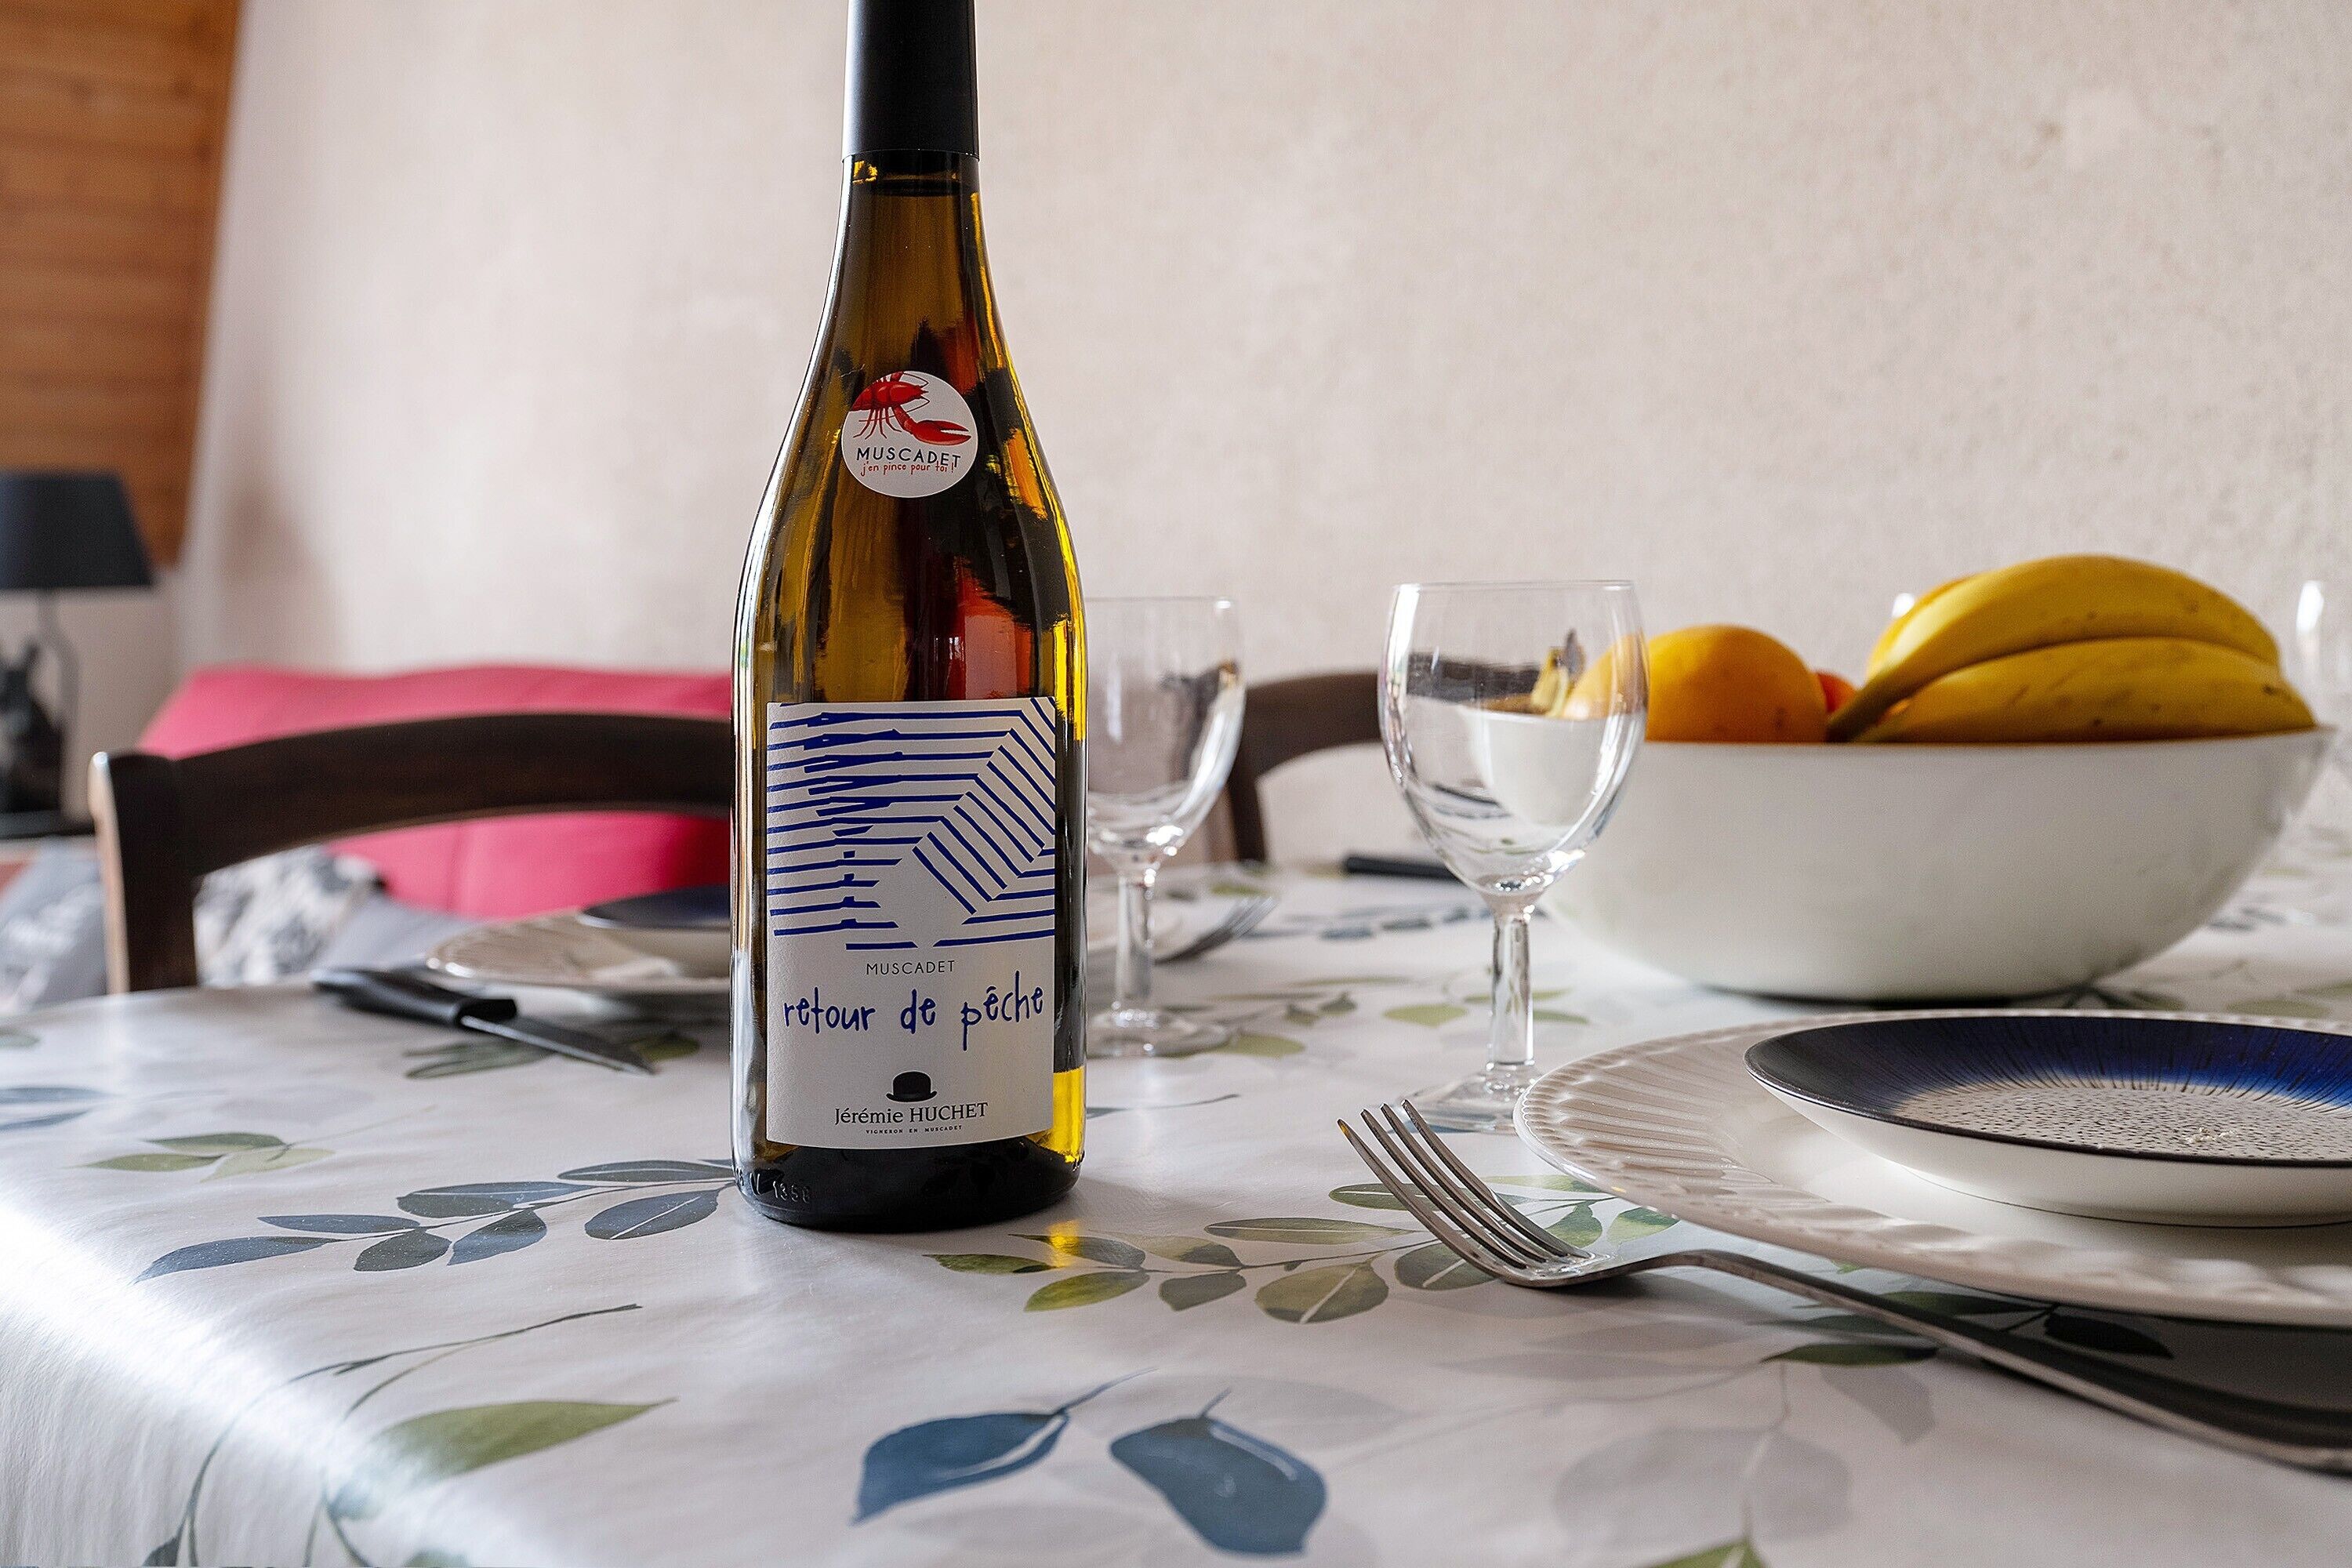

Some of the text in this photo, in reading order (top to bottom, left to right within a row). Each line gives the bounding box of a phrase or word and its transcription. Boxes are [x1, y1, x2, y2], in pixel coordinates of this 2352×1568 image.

[856, 447, 961, 468] MUSCADET
[861, 461, 879, 477] j'en
[883, 462, 906, 475] pince
[910, 463, 931, 475] pour
[935, 460, 948, 472] toi
[866, 960, 955, 975] MUSCADET
[784, 971, 1044, 1051] retour de pêche
[835, 1102, 988, 1125] Jérémie HUCHET
